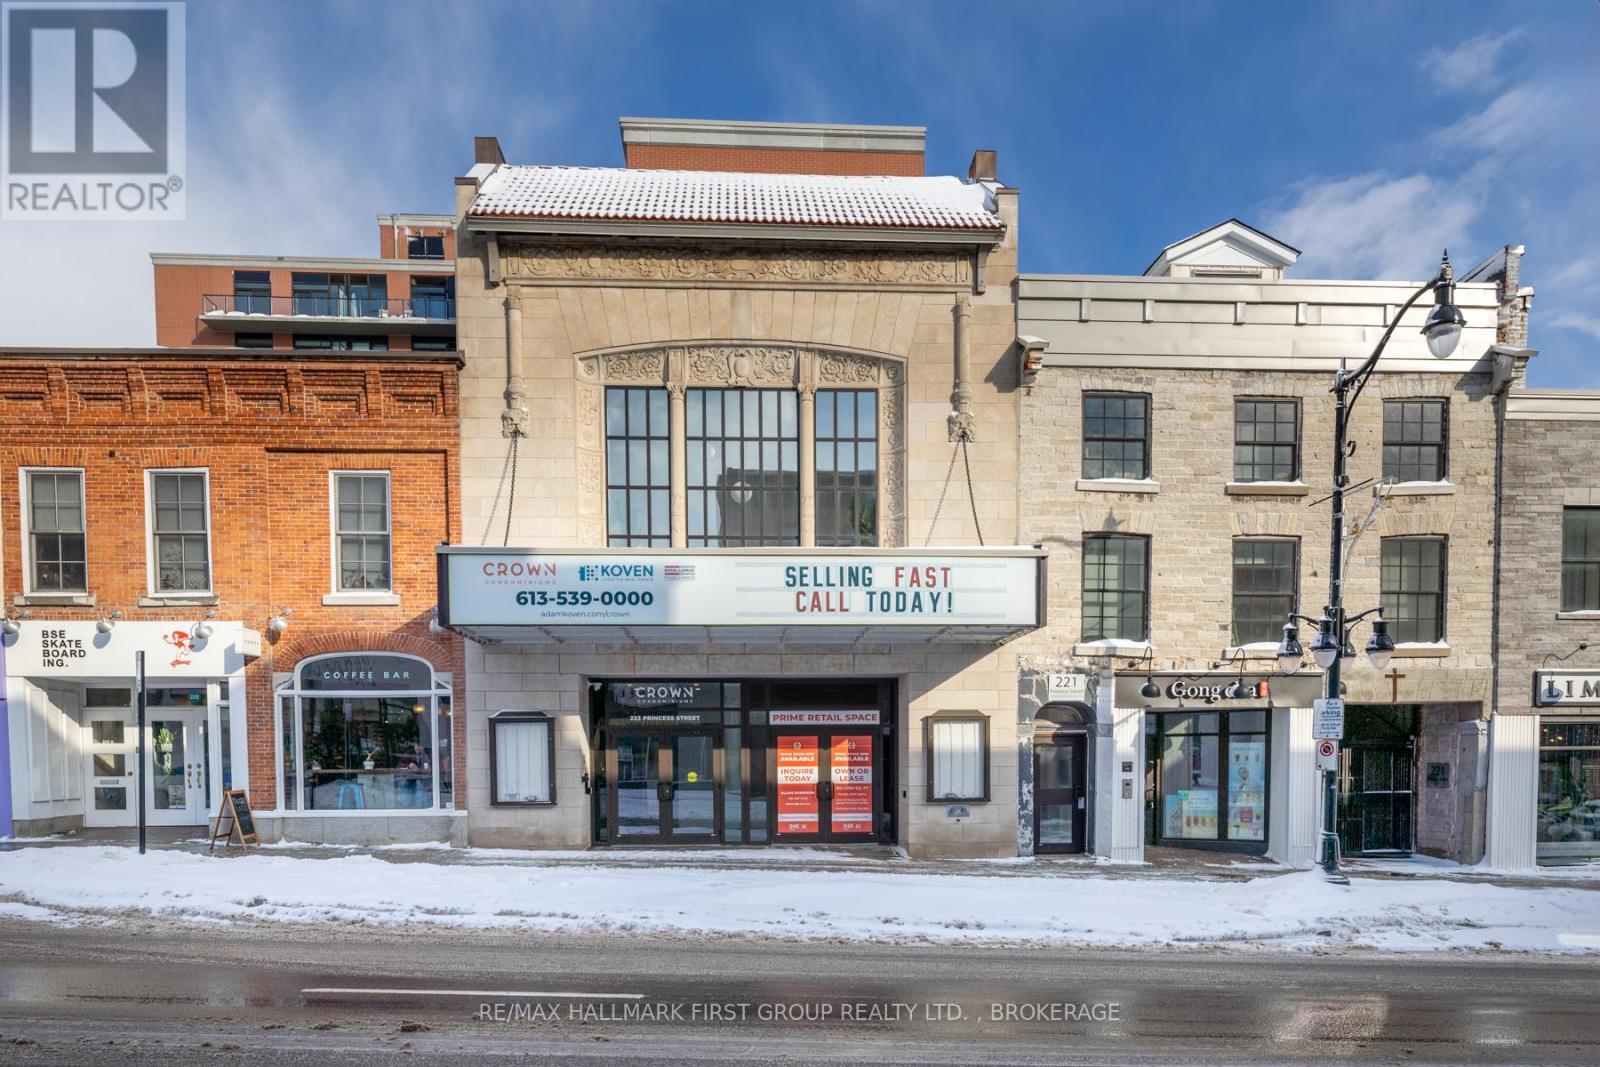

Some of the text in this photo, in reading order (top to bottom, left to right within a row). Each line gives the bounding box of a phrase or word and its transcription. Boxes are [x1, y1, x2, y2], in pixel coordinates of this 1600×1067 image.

[483, 562, 556, 576] CROWN
[601, 565, 654, 577] KOVEN
[785, 566, 951, 588] SELLING FAST
[516, 591, 654, 606] 613-539-0000
[796, 591, 953, 613] CALL TODAY!
[541, 610, 630, 618] adamkoven.com/crown
[42, 630, 66, 638] BSE
[42, 640, 82, 648] SKATE
[43, 649, 86, 658] BOARD
[43, 659, 69, 667] ING.
[323, 671, 410, 679] COFFEE BAR
[1055, 676, 1077, 688] 221
[635, 687, 693, 698] CROWN
[1171, 681, 1222, 701] Gong
